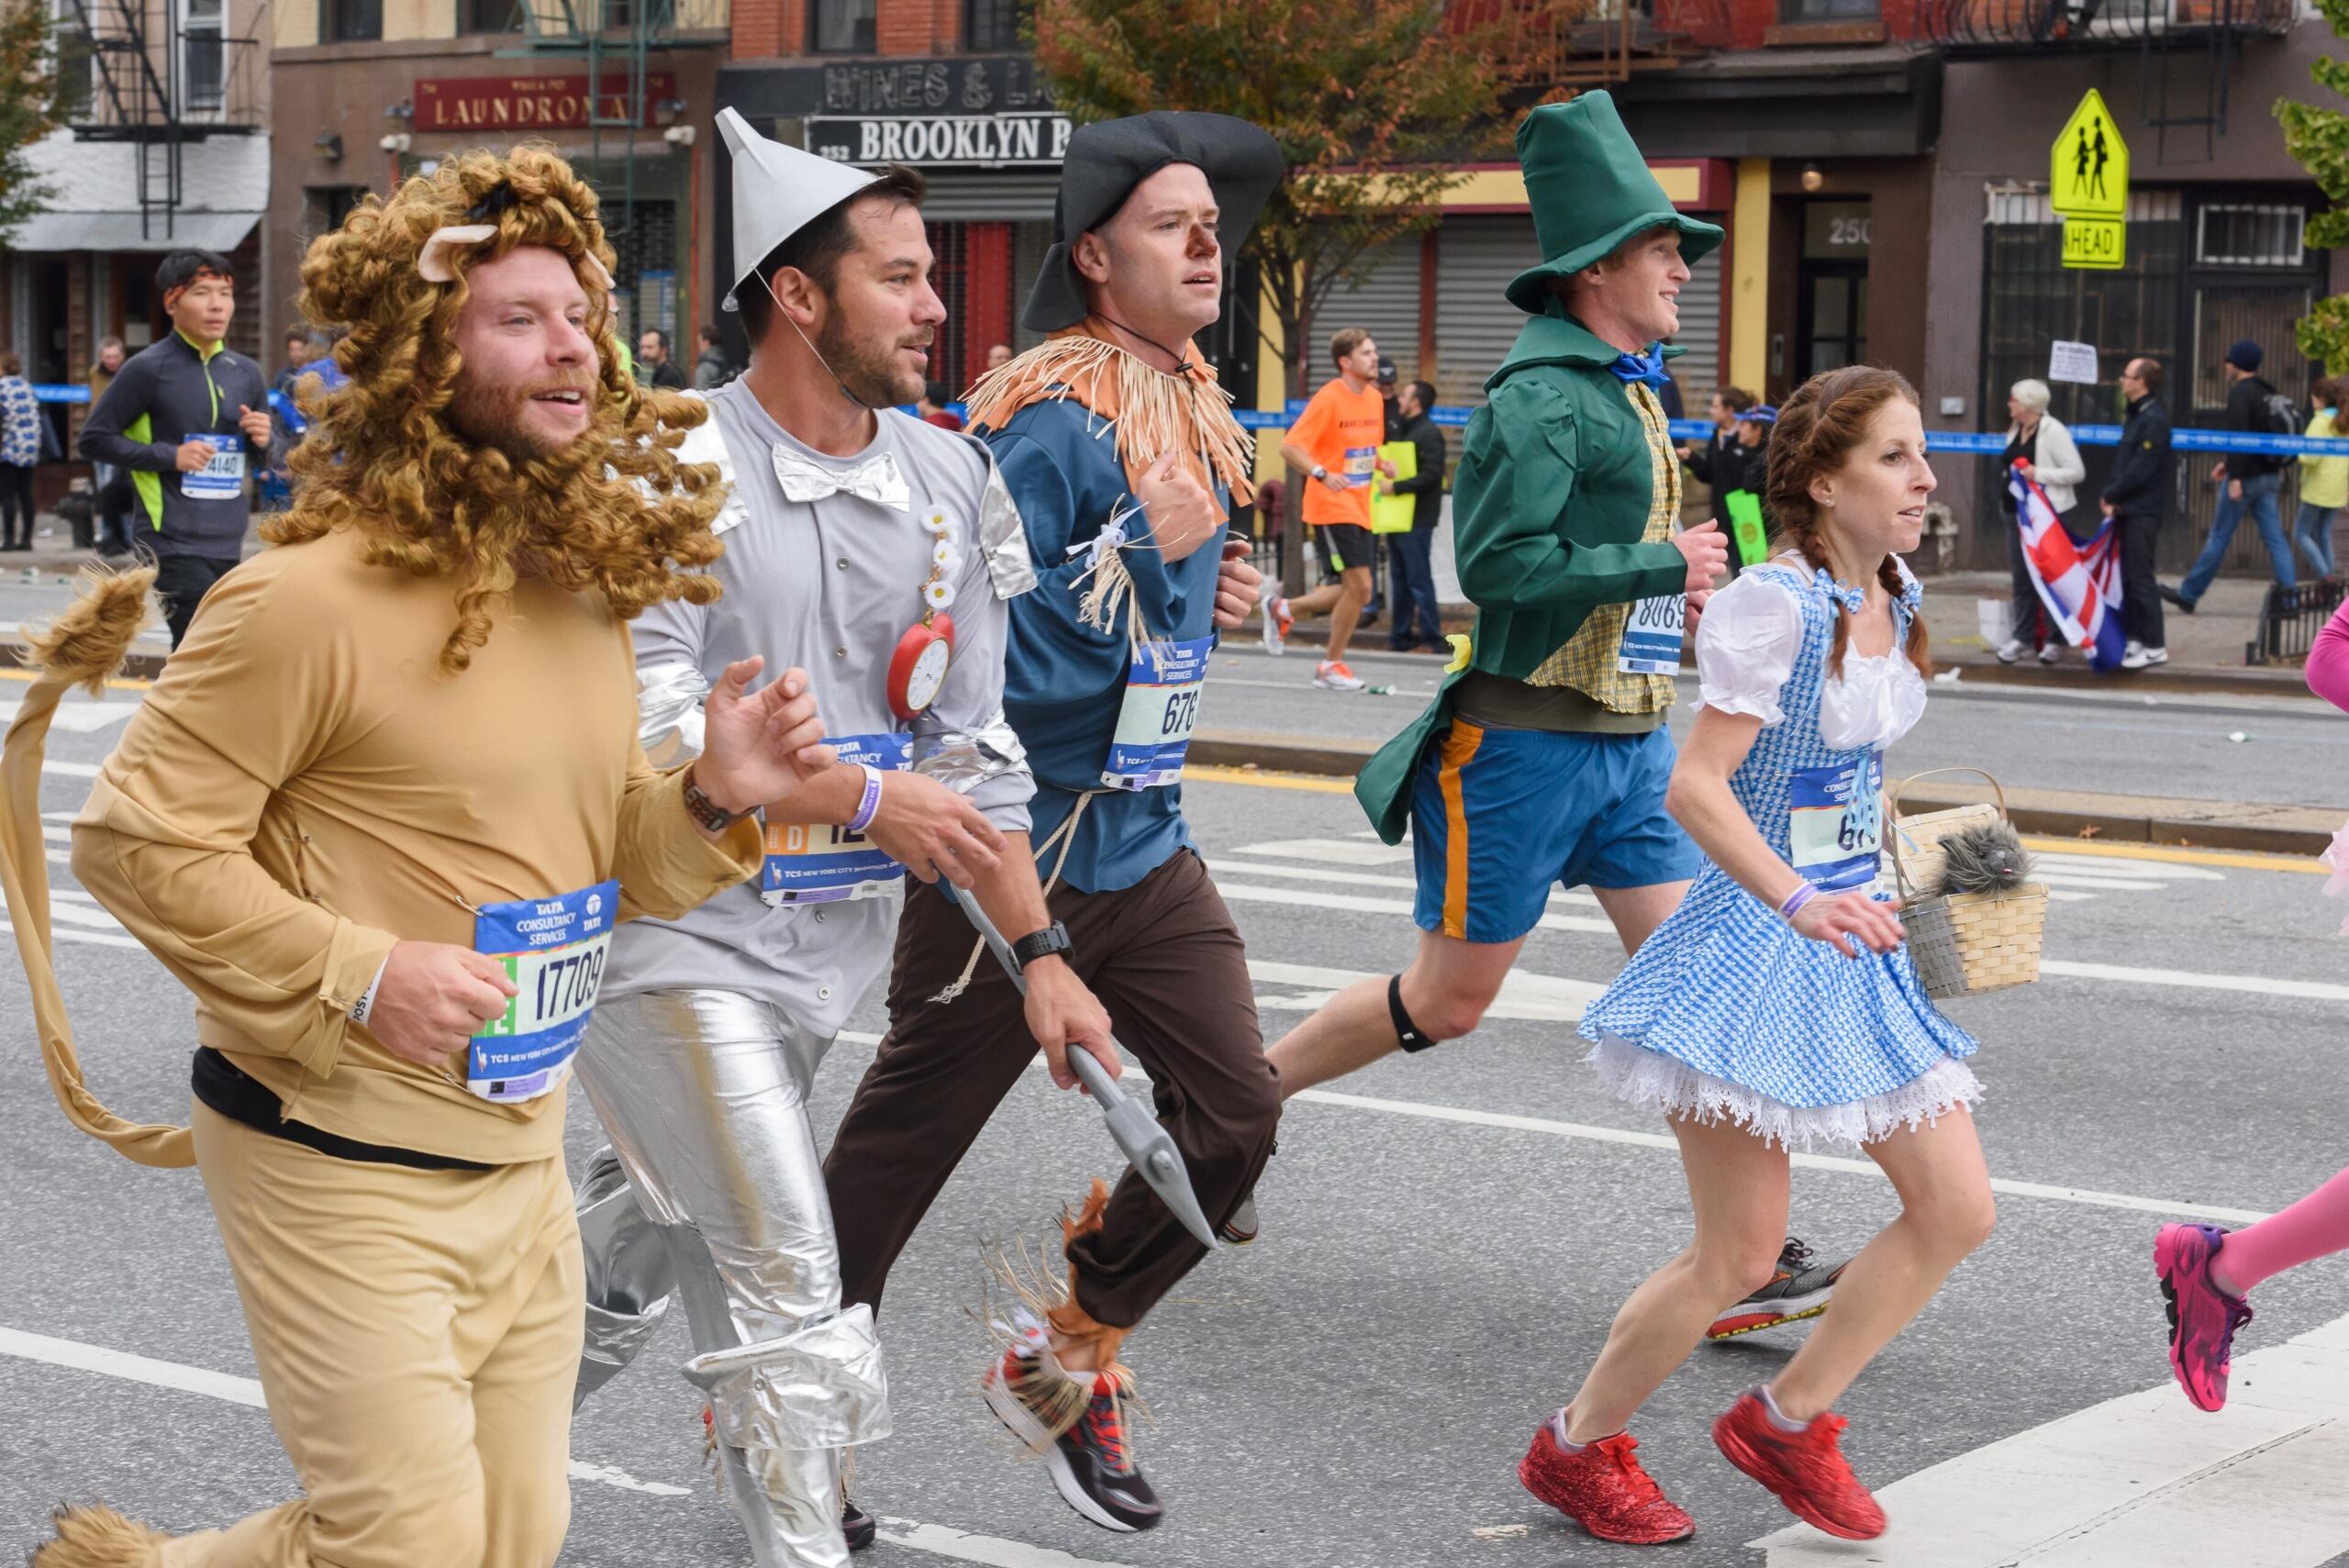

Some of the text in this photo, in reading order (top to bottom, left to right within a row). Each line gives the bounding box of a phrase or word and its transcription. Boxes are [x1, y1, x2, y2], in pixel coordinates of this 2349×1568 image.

[962, 61, 992, 109] &
[435, 95, 647, 124] LAUNDROA
[860, 118, 1041, 161] BROOKLYN
[1050, 118, 1072, 159] B
[1639, 595, 1687, 629] 8069
[787, 826, 803, 851] D
[785, 870, 802, 878] TCS
[536, 901, 564, 916] TATA
[516, 911, 577, 933] CONSULTANCY
[529, 928, 567, 946] SERVICES
[536, 945, 605, 1021] 17709
[490, 1053, 509, 1064] TCS
[510, 1052, 527, 1062] NEW
